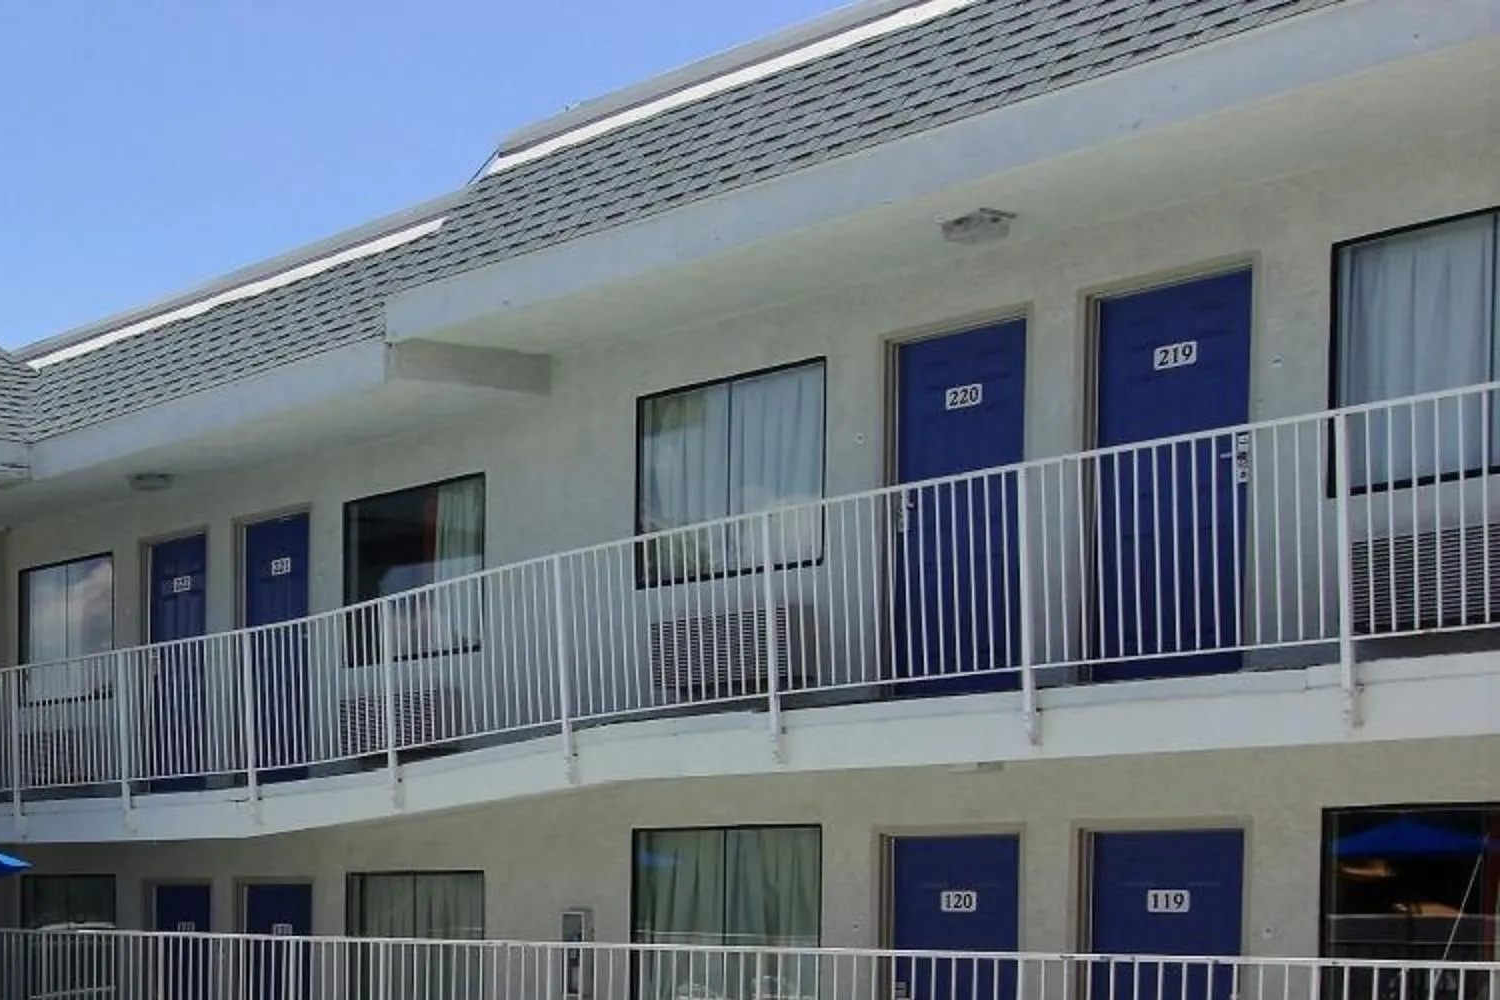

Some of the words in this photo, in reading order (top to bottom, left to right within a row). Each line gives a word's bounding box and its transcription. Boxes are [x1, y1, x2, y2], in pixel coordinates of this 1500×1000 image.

[1157, 344, 1194, 367] 219
[948, 386, 980, 406] 220
[944, 892, 973, 909] 120
[1152, 892, 1186, 910] 119
